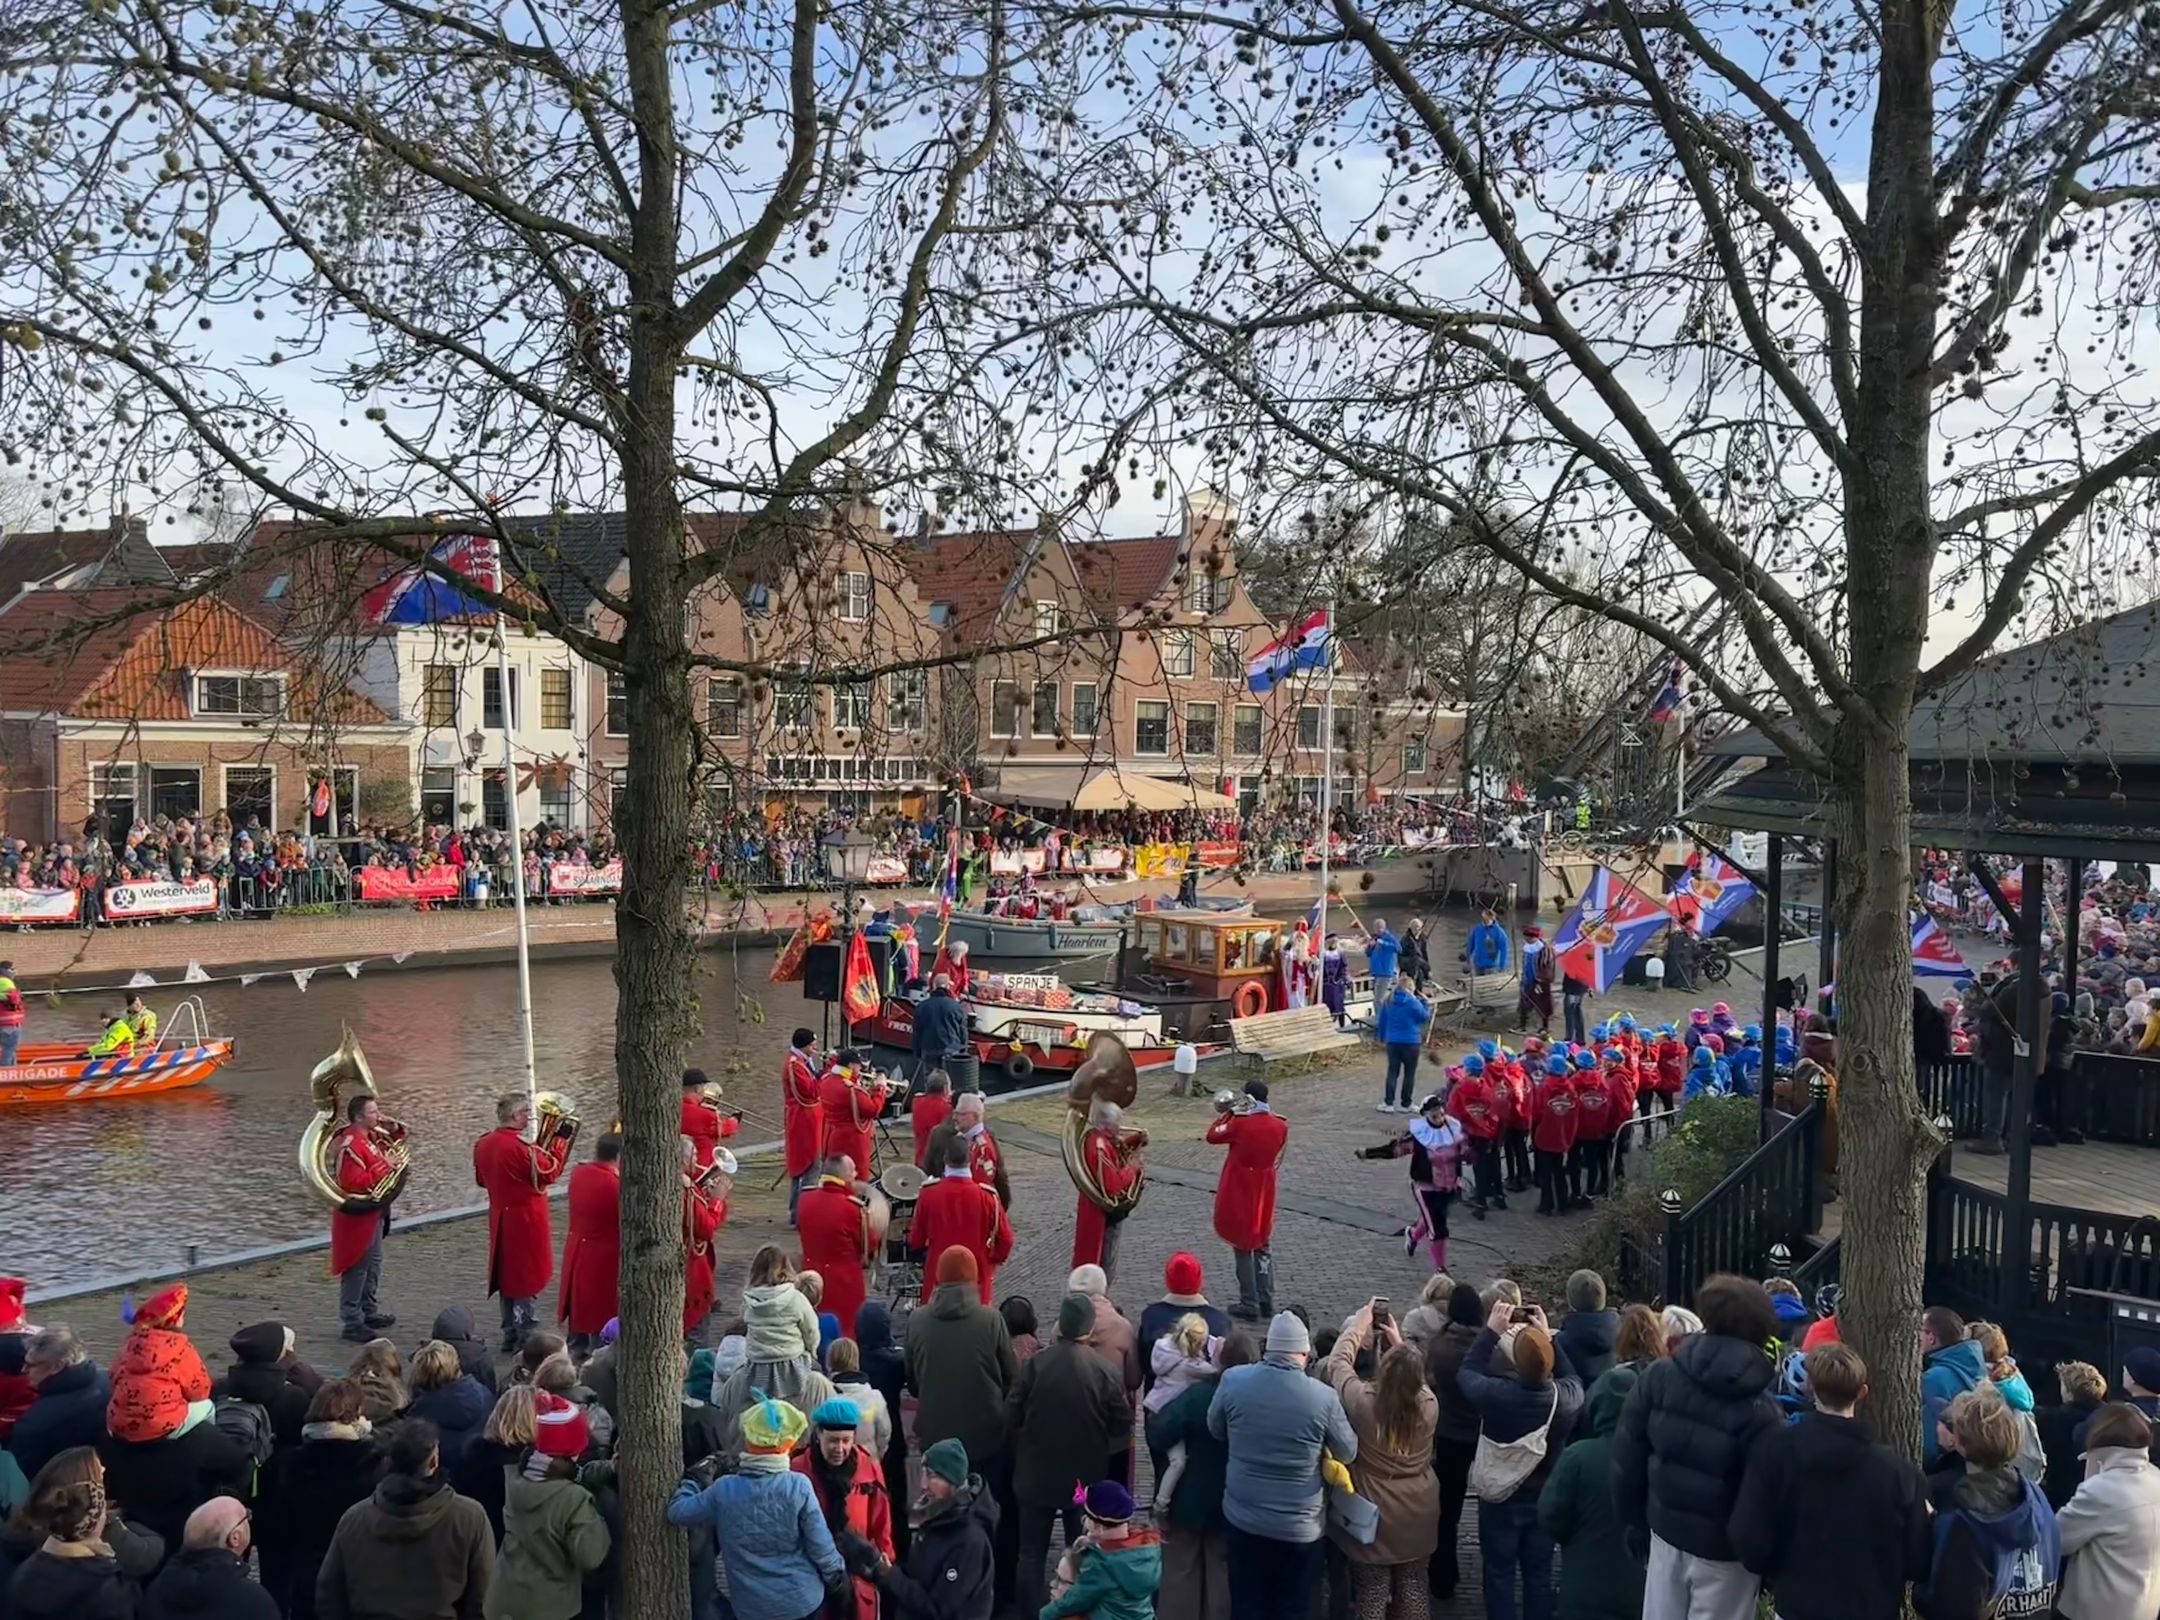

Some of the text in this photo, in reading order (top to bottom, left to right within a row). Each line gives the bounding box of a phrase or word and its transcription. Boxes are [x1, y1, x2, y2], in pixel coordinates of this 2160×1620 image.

[140, 883, 210, 898] Westerveld
[1058, 934, 1107, 949] Haarlem
[1008, 976, 1053, 989] SPANJE
